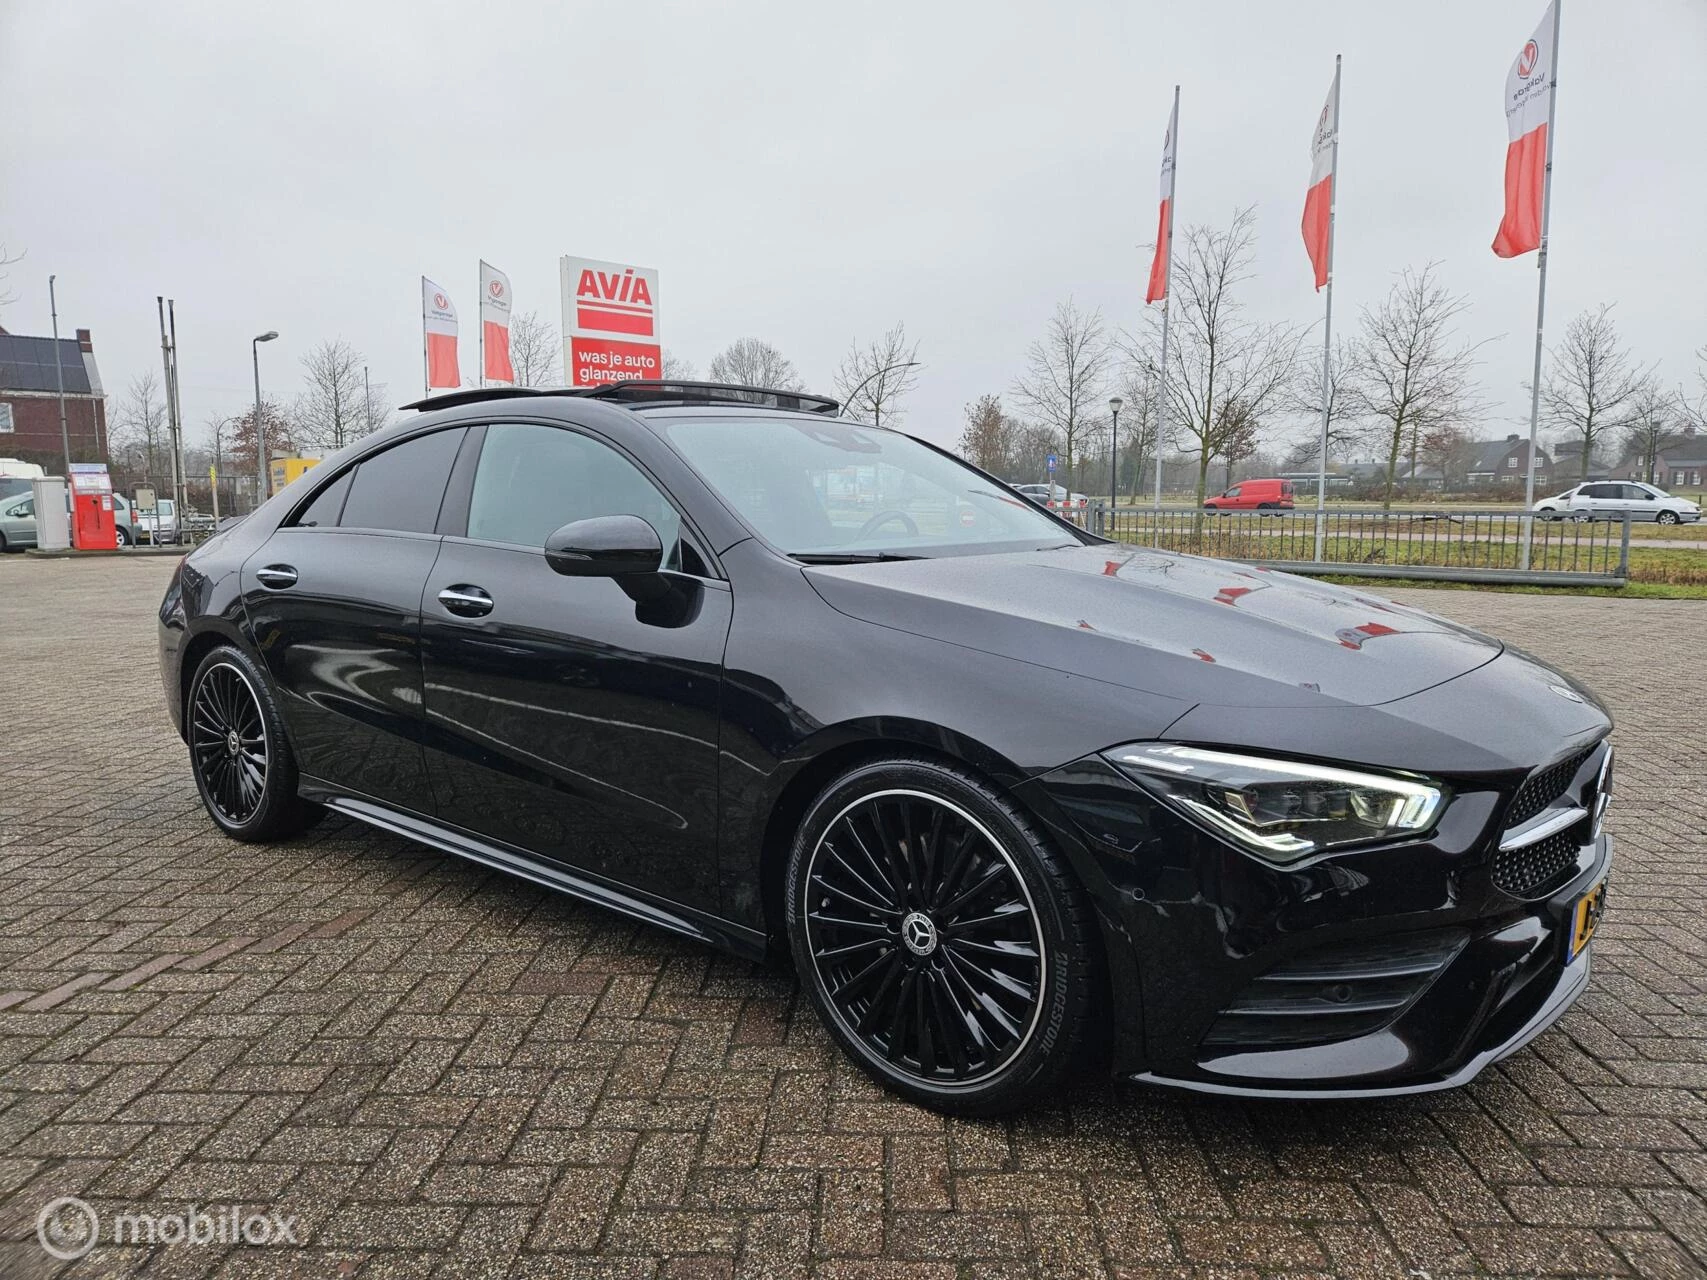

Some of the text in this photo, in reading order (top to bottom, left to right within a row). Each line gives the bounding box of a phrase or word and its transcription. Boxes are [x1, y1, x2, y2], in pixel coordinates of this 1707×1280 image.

[579, 351, 655, 368] was je auto
[580, 366, 643, 382] glanzend
[788, 834, 806, 925] BRIDGESTONE
[1040, 951, 1068, 1056] BRIDGESTONE
